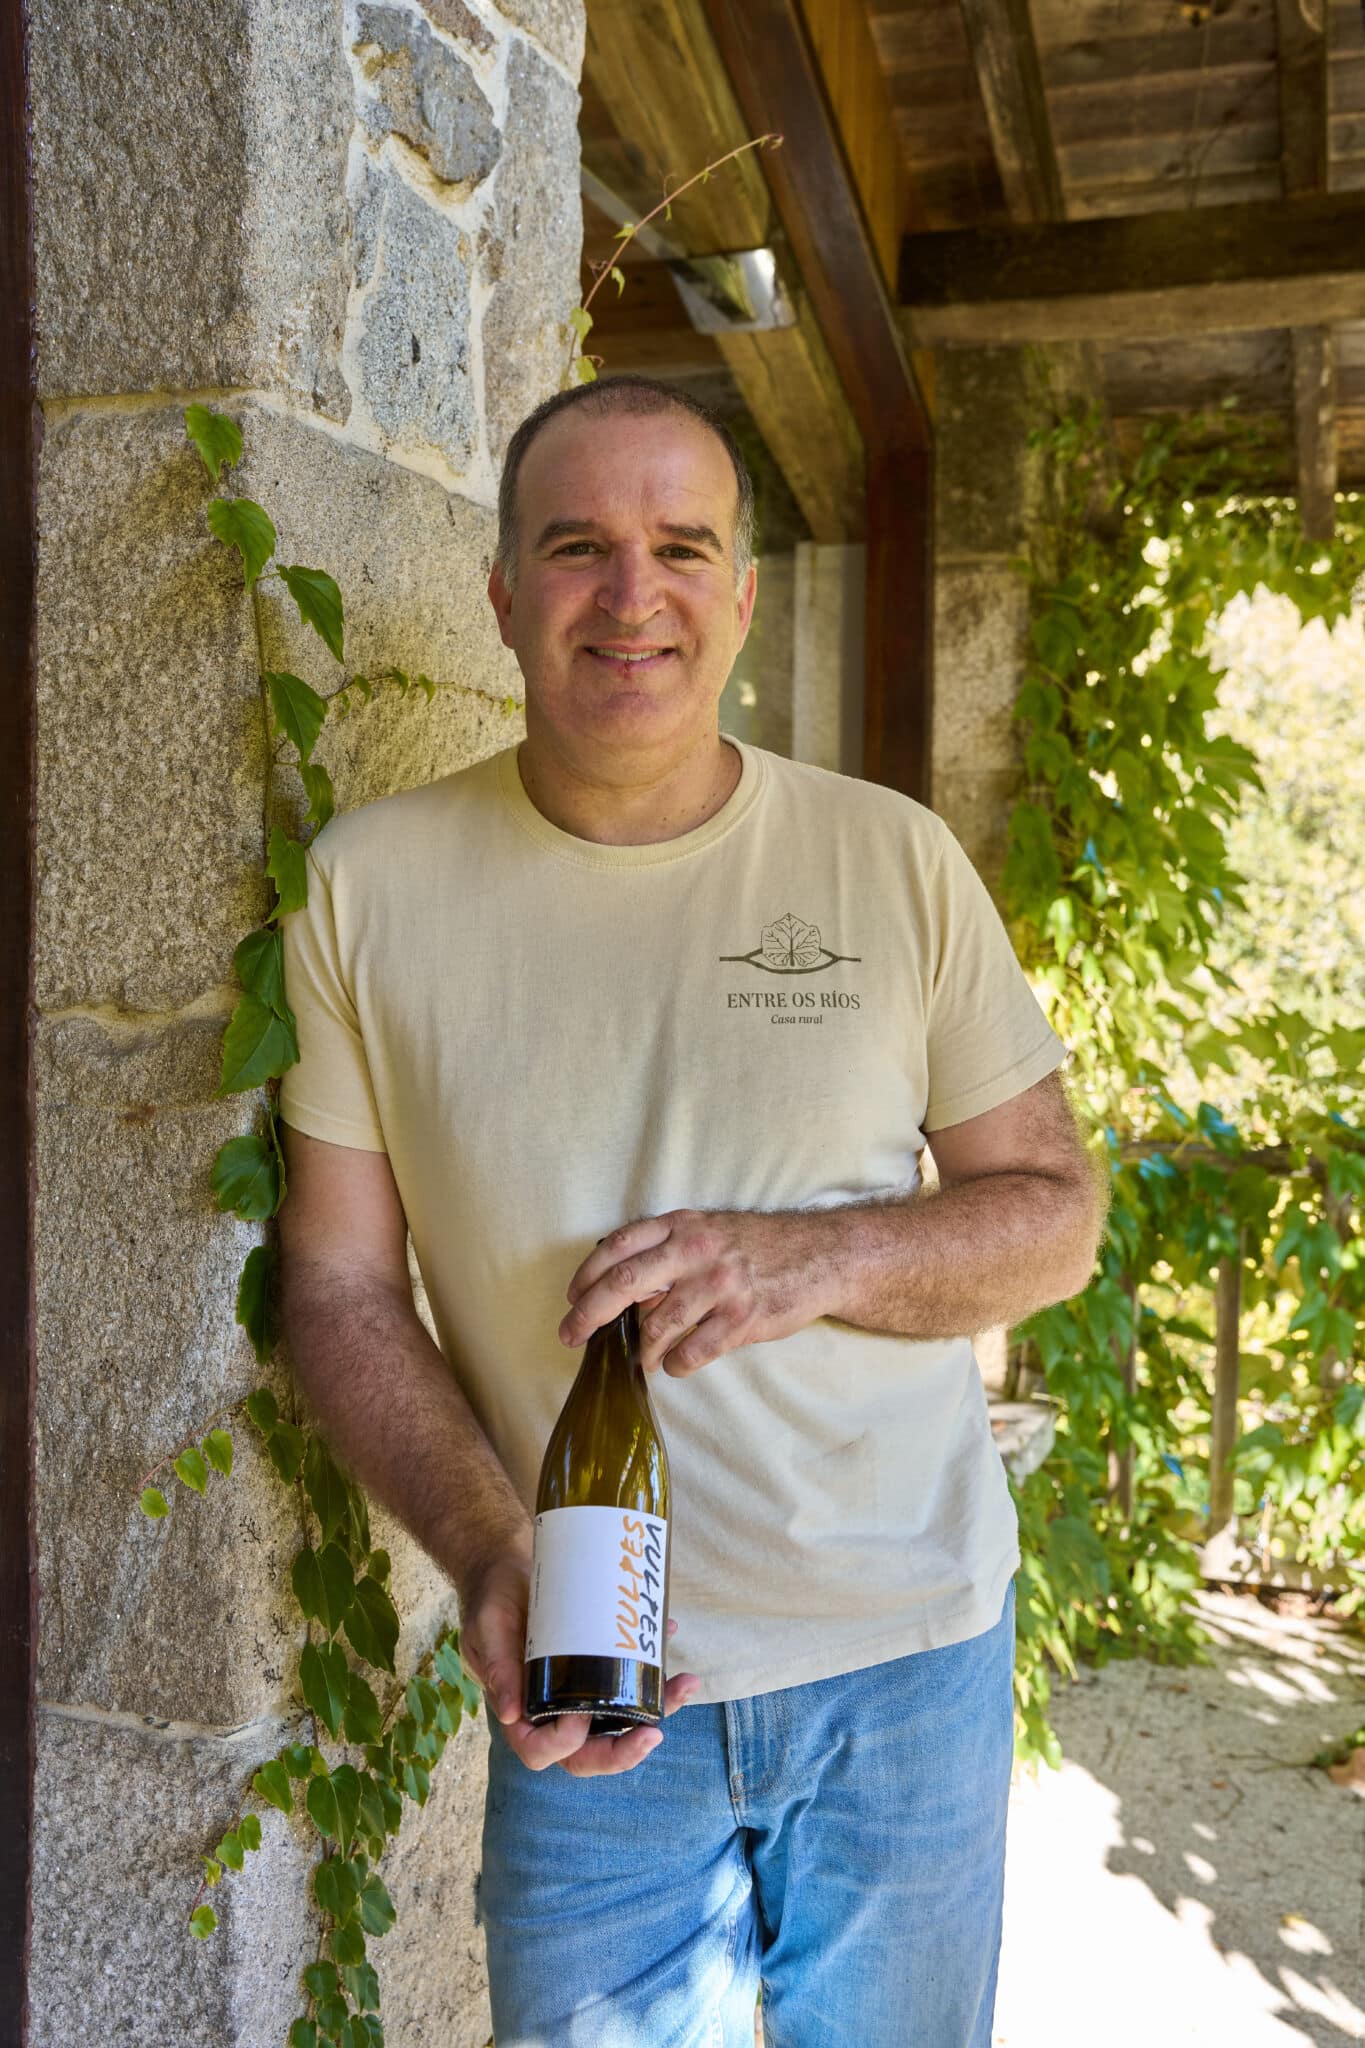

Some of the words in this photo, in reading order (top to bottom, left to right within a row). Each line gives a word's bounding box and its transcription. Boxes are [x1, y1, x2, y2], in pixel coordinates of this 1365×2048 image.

[727, 992, 787, 1008] ENTRE
[792, 992, 815, 1008] OS
[820, 990, 861, 1009] RÍOS
[771, 1014, 796, 1024] Casa
[799, 1014, 823, 1024] rural
[615, 1515, 645, 1651] VULPES
[639, 1523, 662, 1658] VULPES
